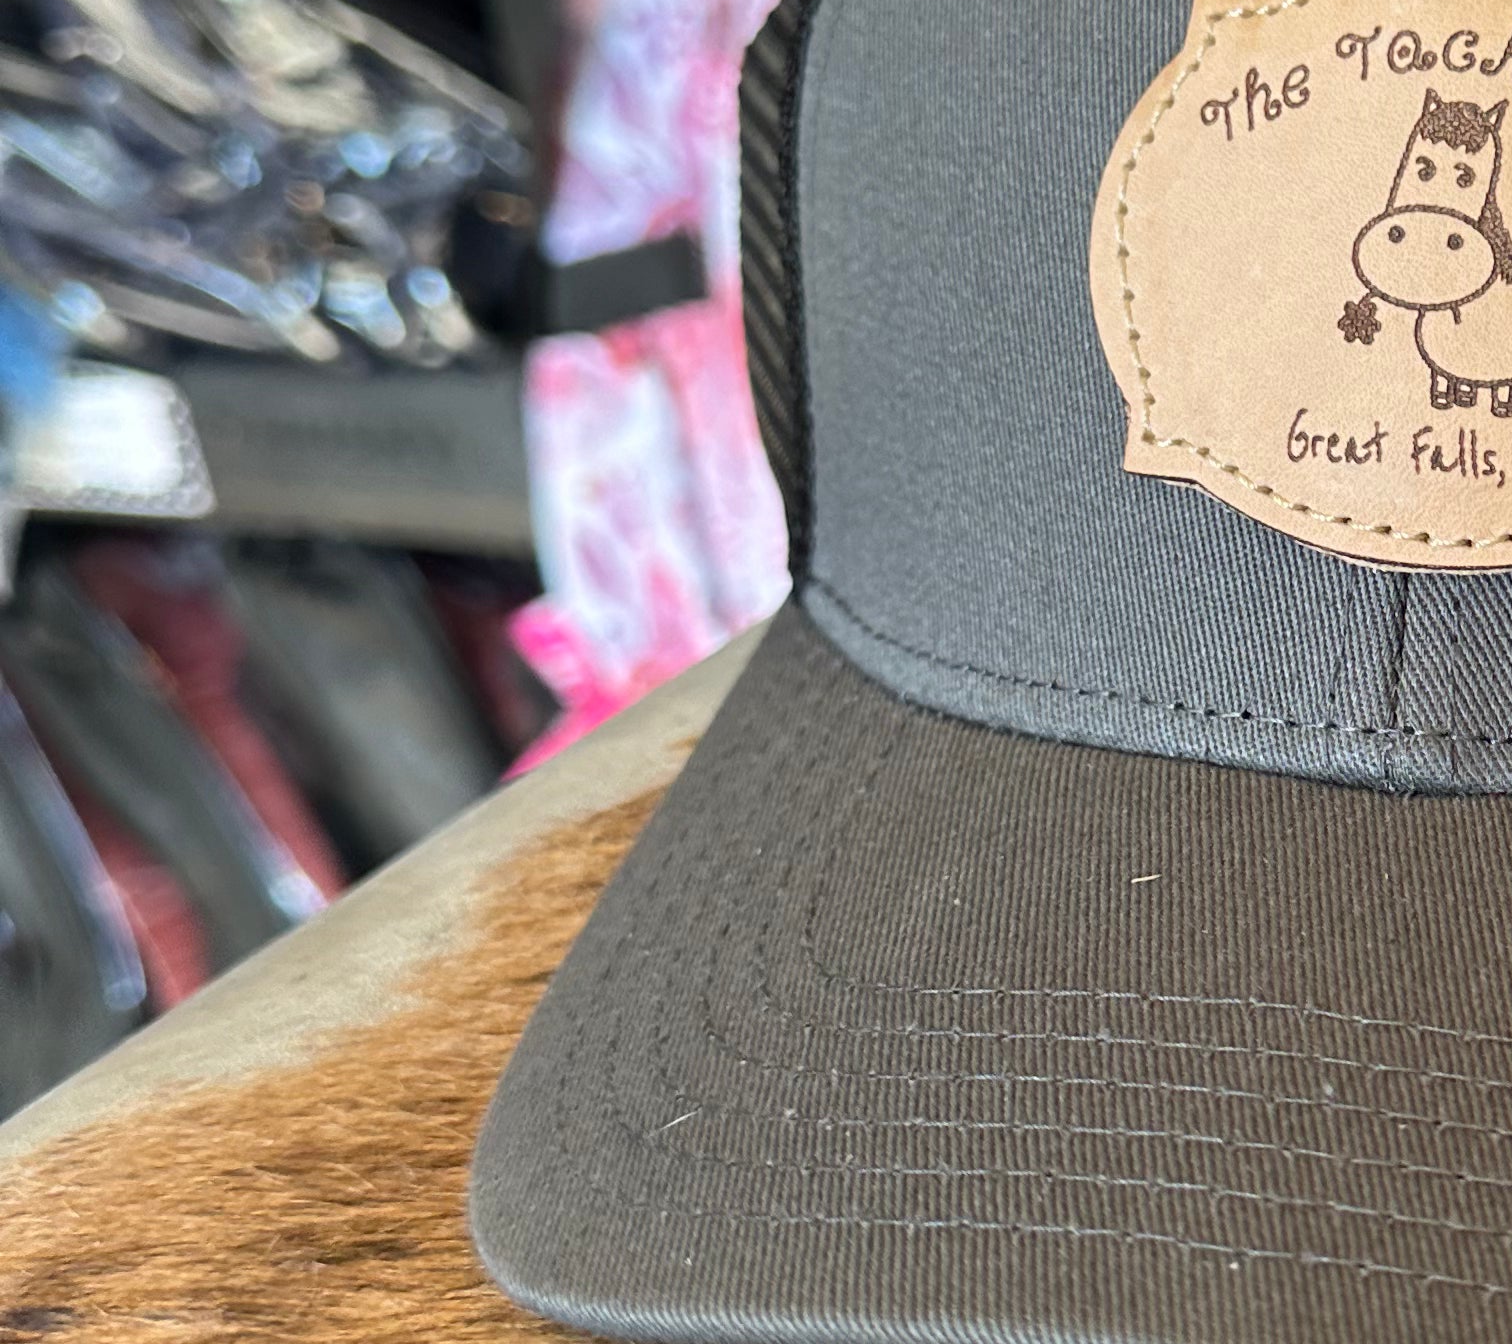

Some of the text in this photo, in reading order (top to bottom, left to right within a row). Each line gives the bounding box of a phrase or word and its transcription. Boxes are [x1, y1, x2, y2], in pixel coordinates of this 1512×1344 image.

[1200, 64, 1311, 142] The
[1286, 408, 1390, 464] Great
[1410, 426, 1508, 488] Falls,
